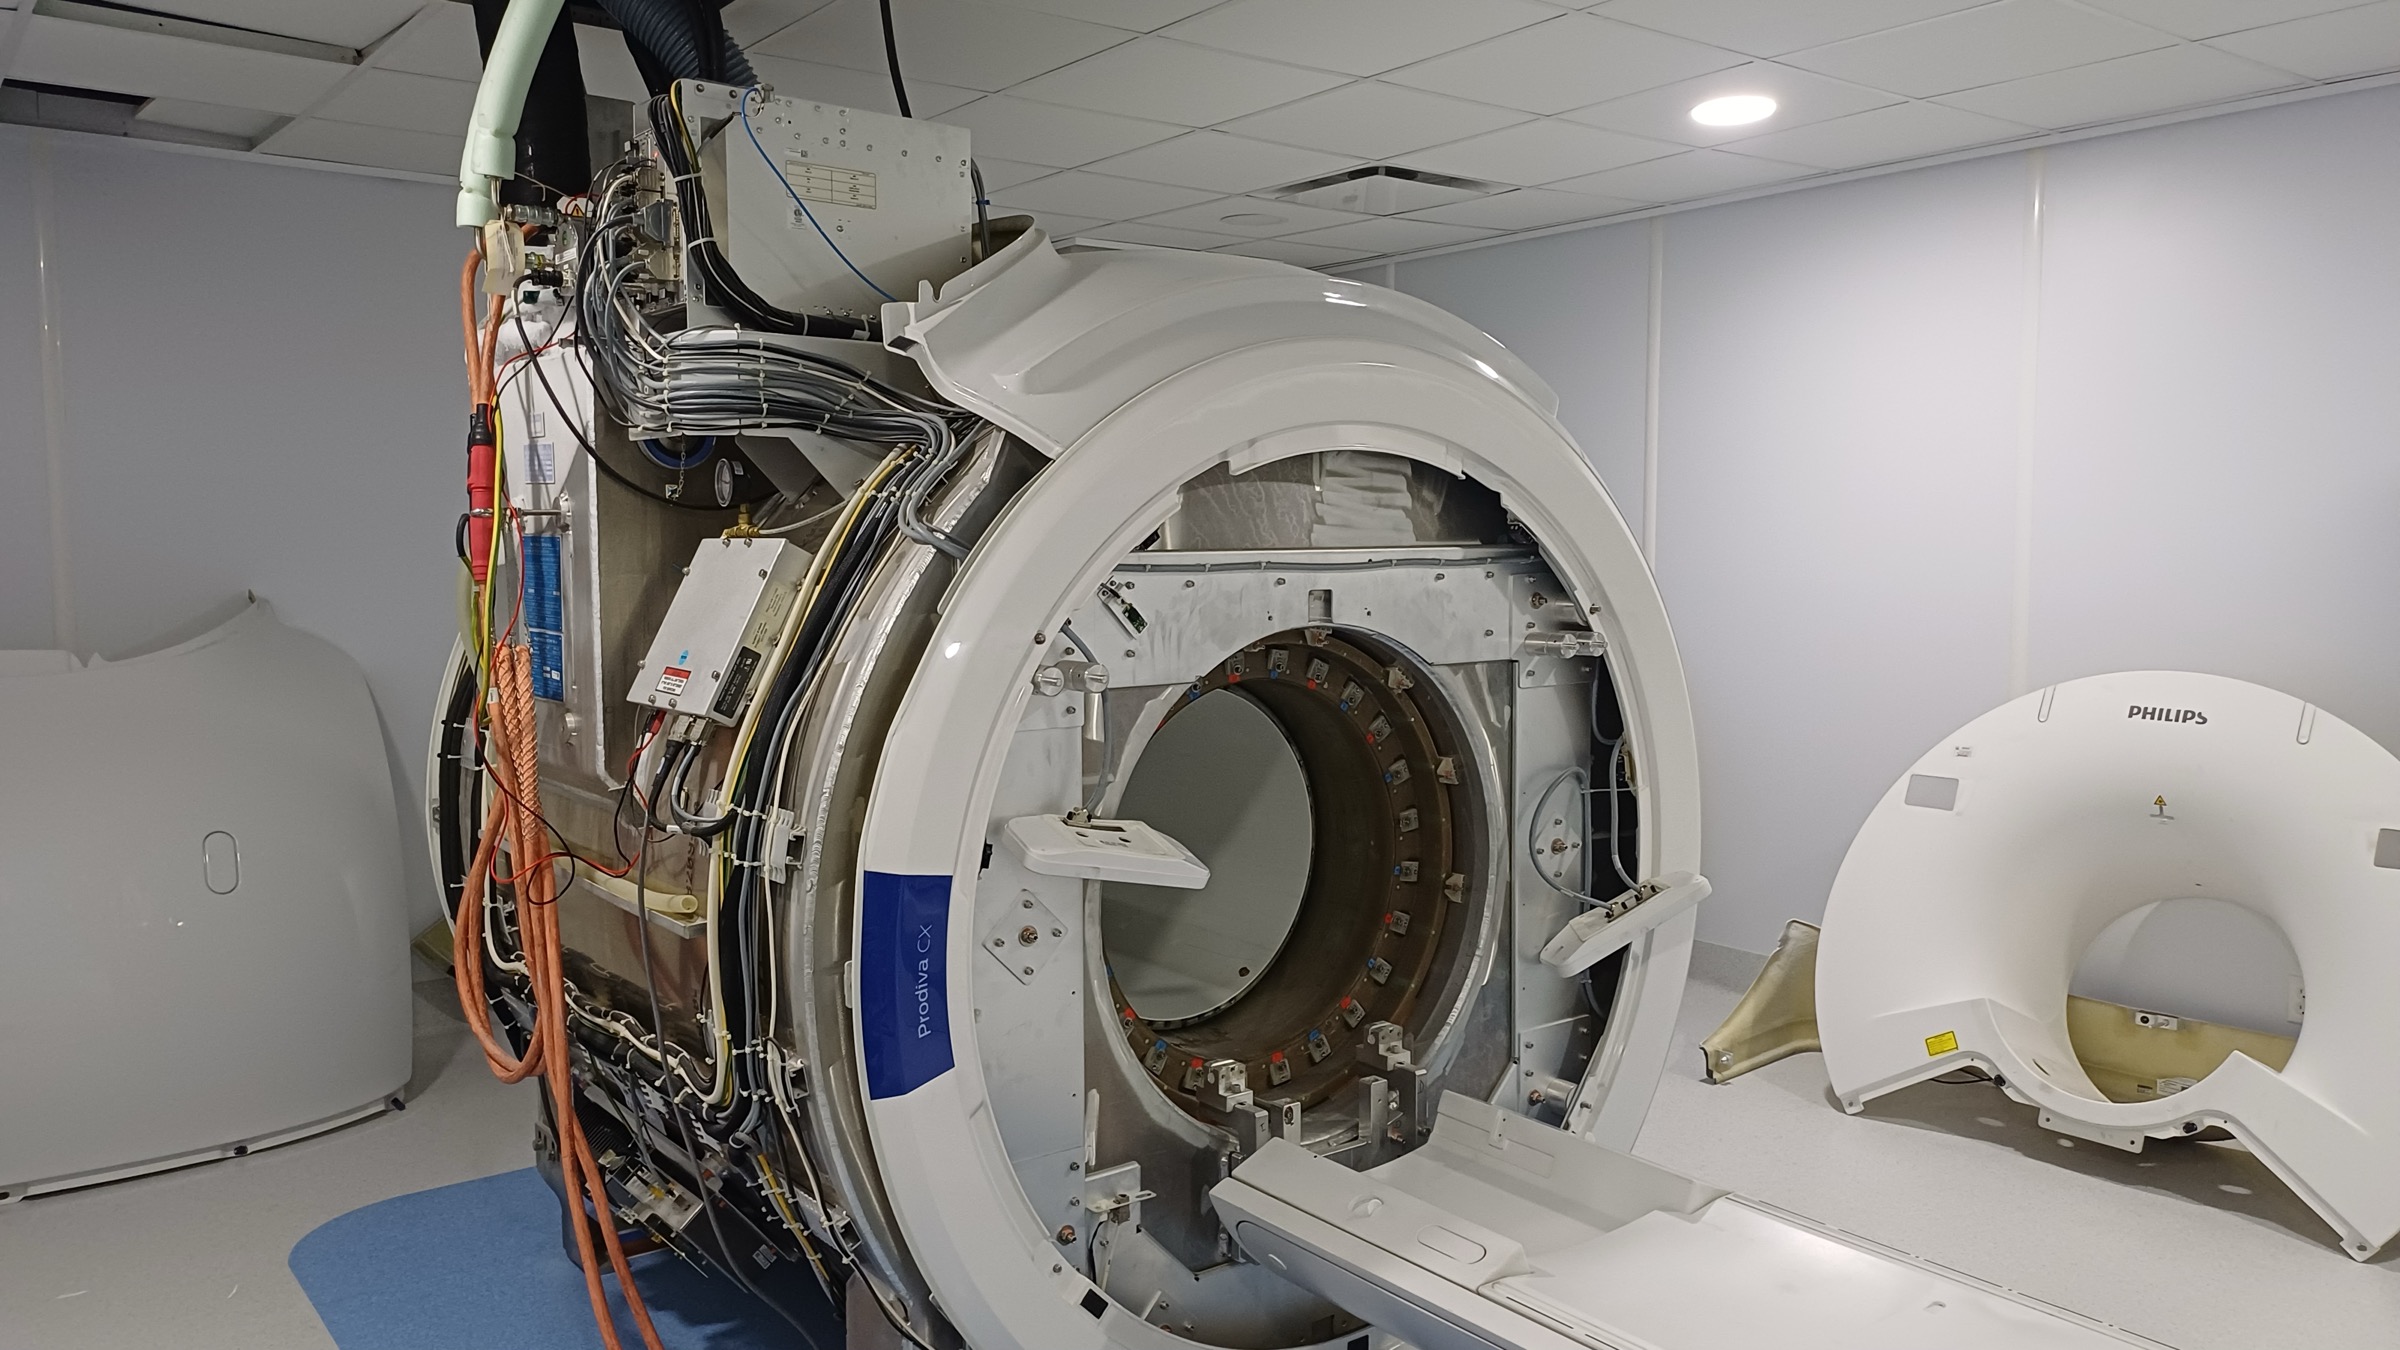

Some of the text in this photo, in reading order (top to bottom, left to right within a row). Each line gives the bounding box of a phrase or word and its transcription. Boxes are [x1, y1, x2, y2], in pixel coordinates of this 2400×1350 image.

[2128, 705, 2208, 725] PHILIPS
[914, 925, 932, 1039] Prodiva CX
